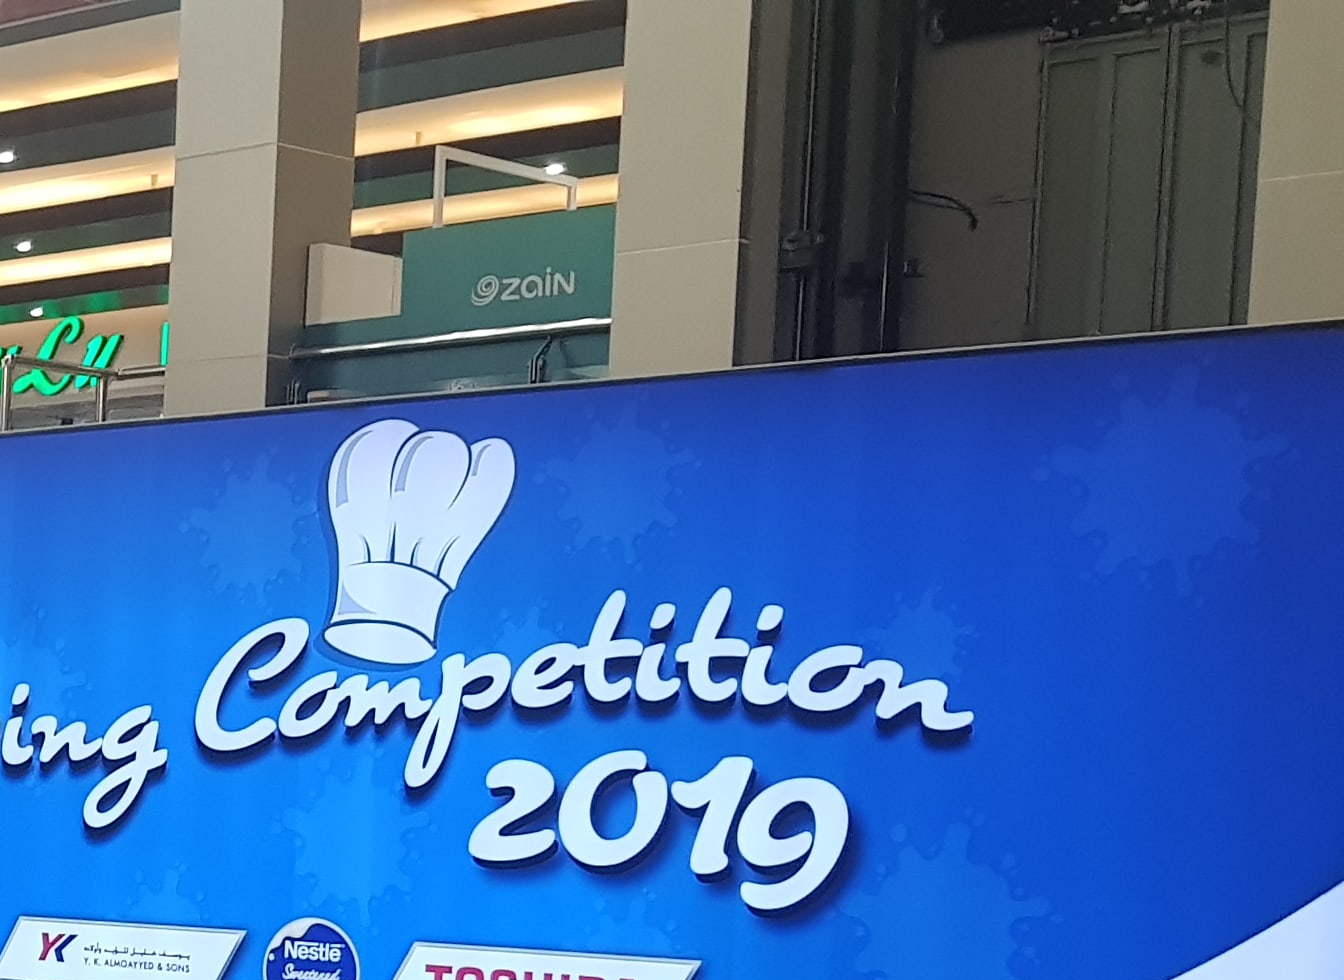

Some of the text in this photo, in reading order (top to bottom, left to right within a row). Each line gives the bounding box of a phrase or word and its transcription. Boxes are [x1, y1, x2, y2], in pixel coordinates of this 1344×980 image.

[194, 587, 974, 792] Competition
[467, 749, 851, 912] 2019
[83, 957, 190, 973] Y. K. ALMOAYYED & SONS
